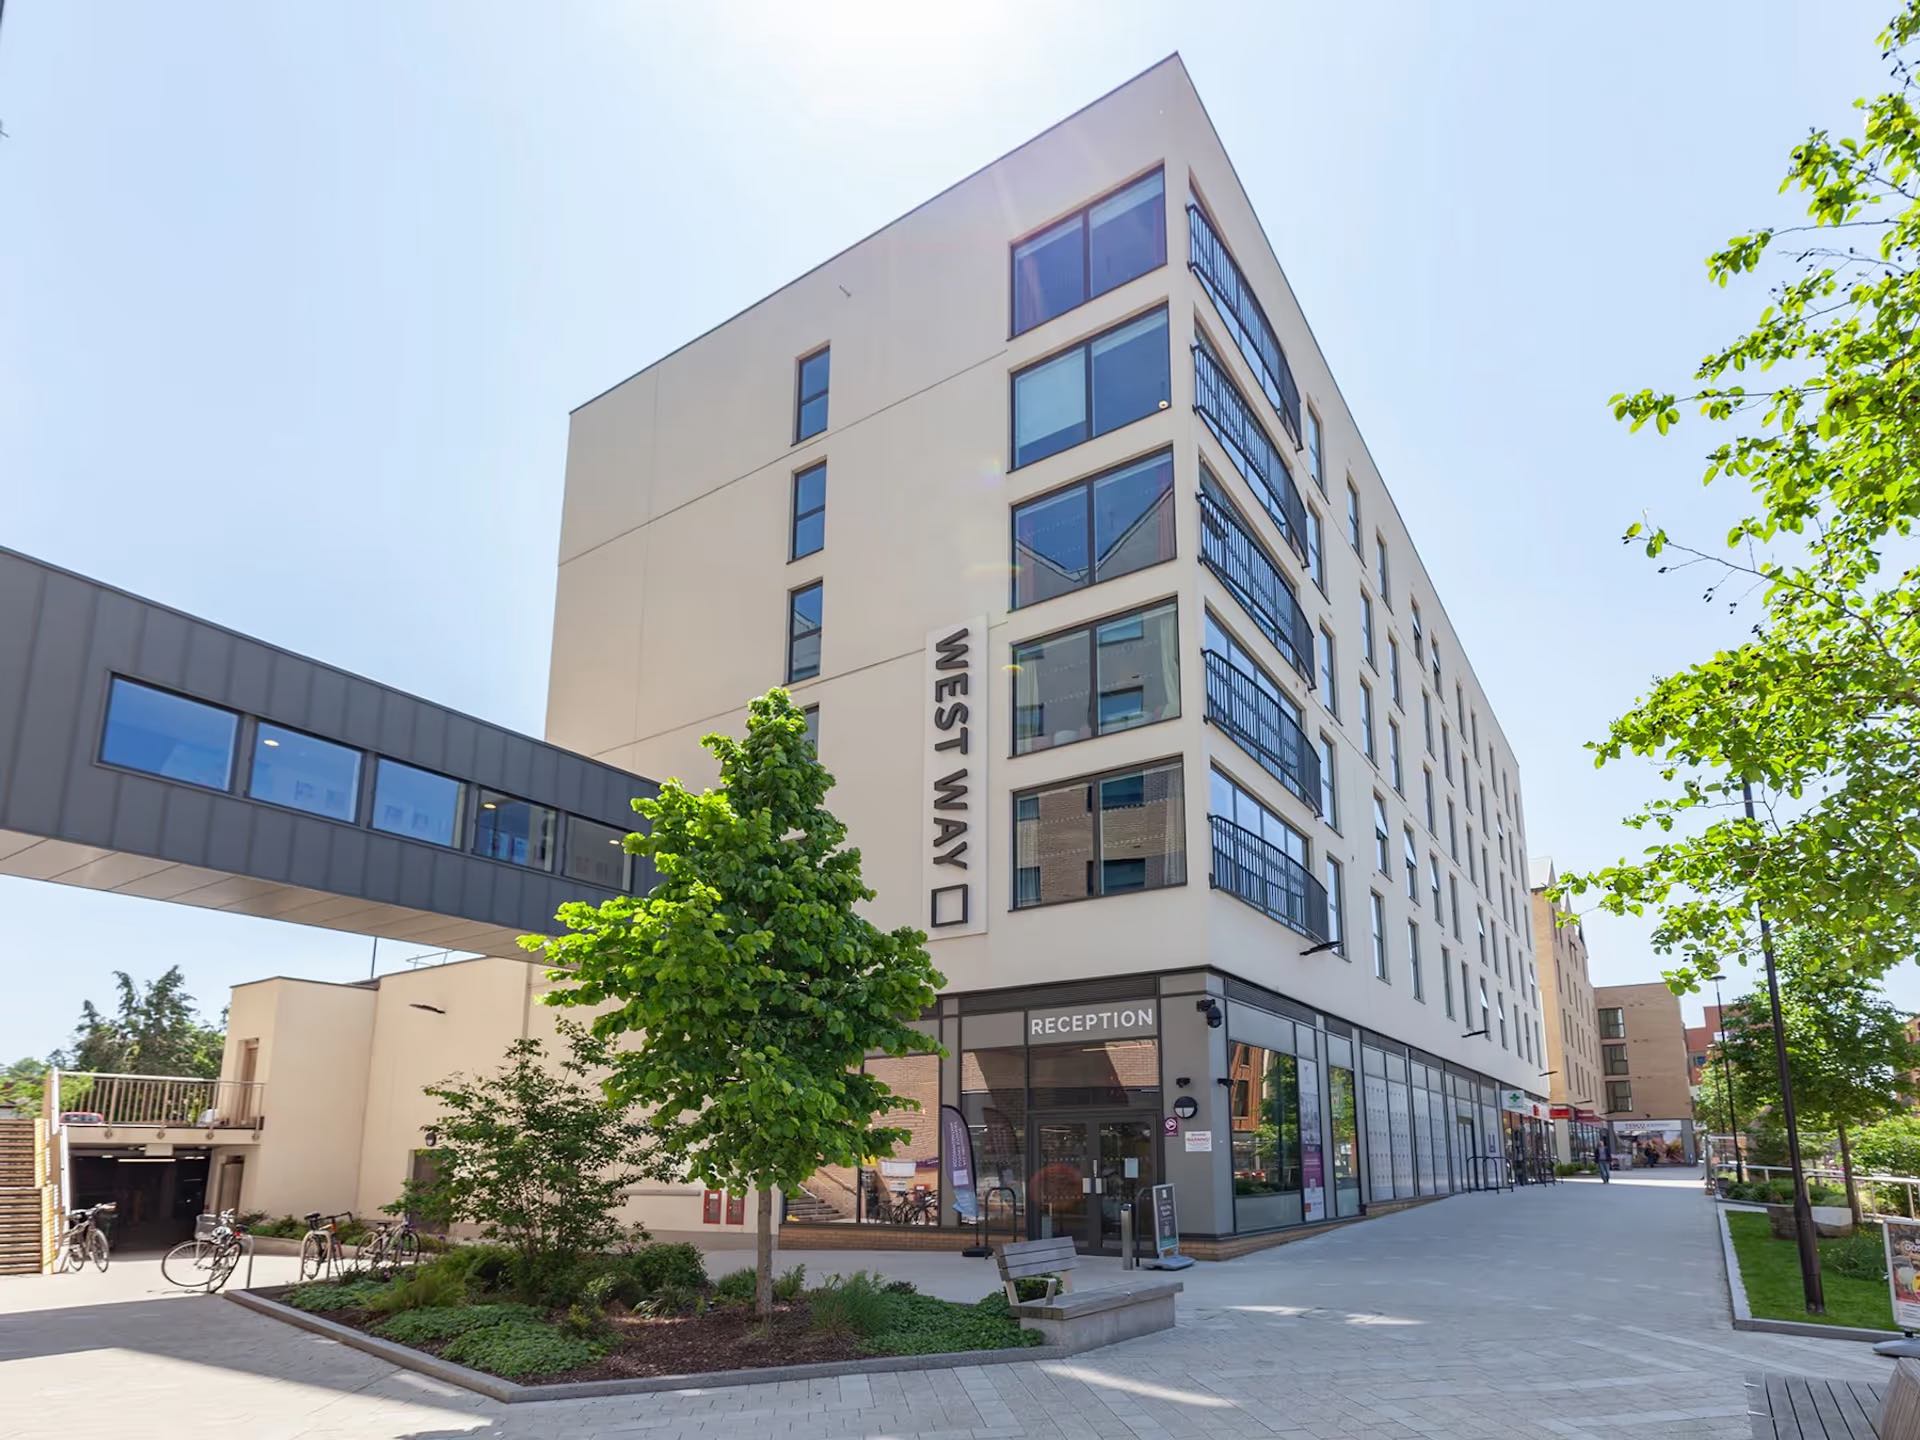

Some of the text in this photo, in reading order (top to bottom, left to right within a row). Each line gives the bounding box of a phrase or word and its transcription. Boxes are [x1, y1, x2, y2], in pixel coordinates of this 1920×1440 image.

[932, 627, 969, 870] WEST WAY
[1031, 1008, 1153, 1035] RECEPTION
